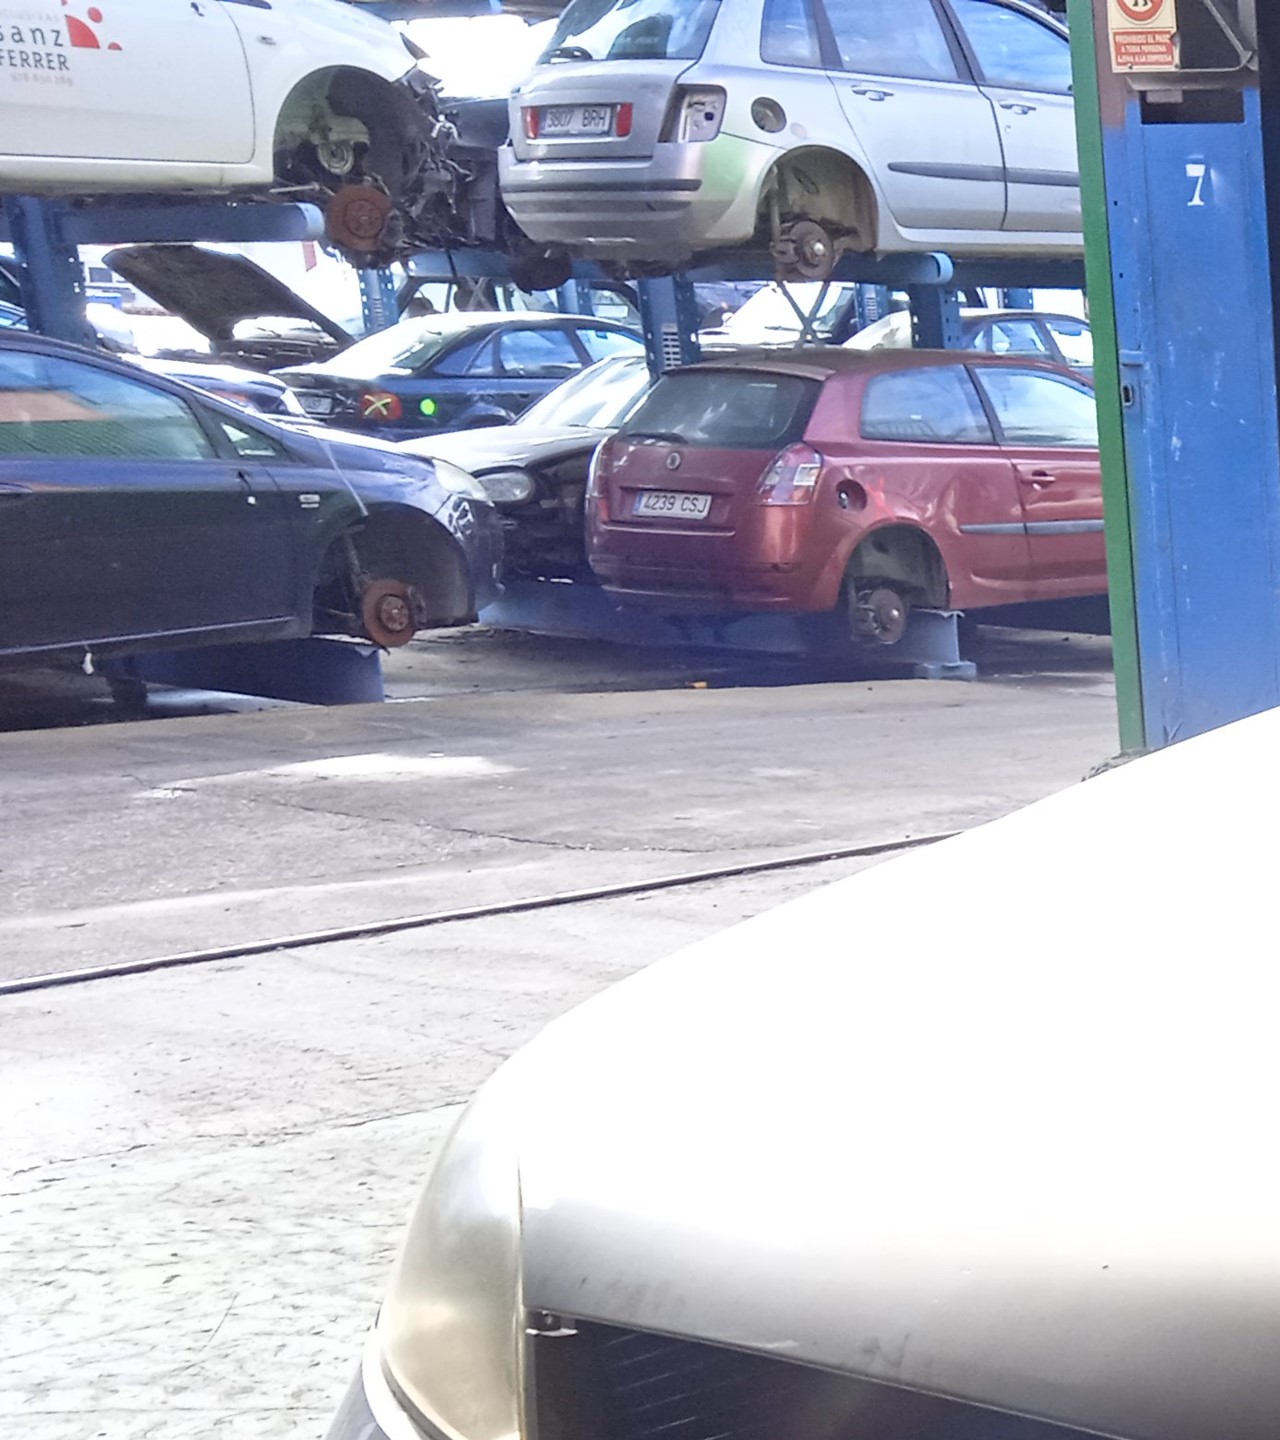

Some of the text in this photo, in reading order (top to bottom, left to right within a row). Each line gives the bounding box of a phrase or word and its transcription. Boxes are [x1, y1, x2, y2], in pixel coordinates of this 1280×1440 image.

[1115, 34, 1147, 43] PROHIBIDO
[1147, 34, 1155, 43] EL
[1141, 44, 1167, 53] PERSONA
[1185, 163, 1206, 207] 7
[680, 495, 709, 514] CSJ
